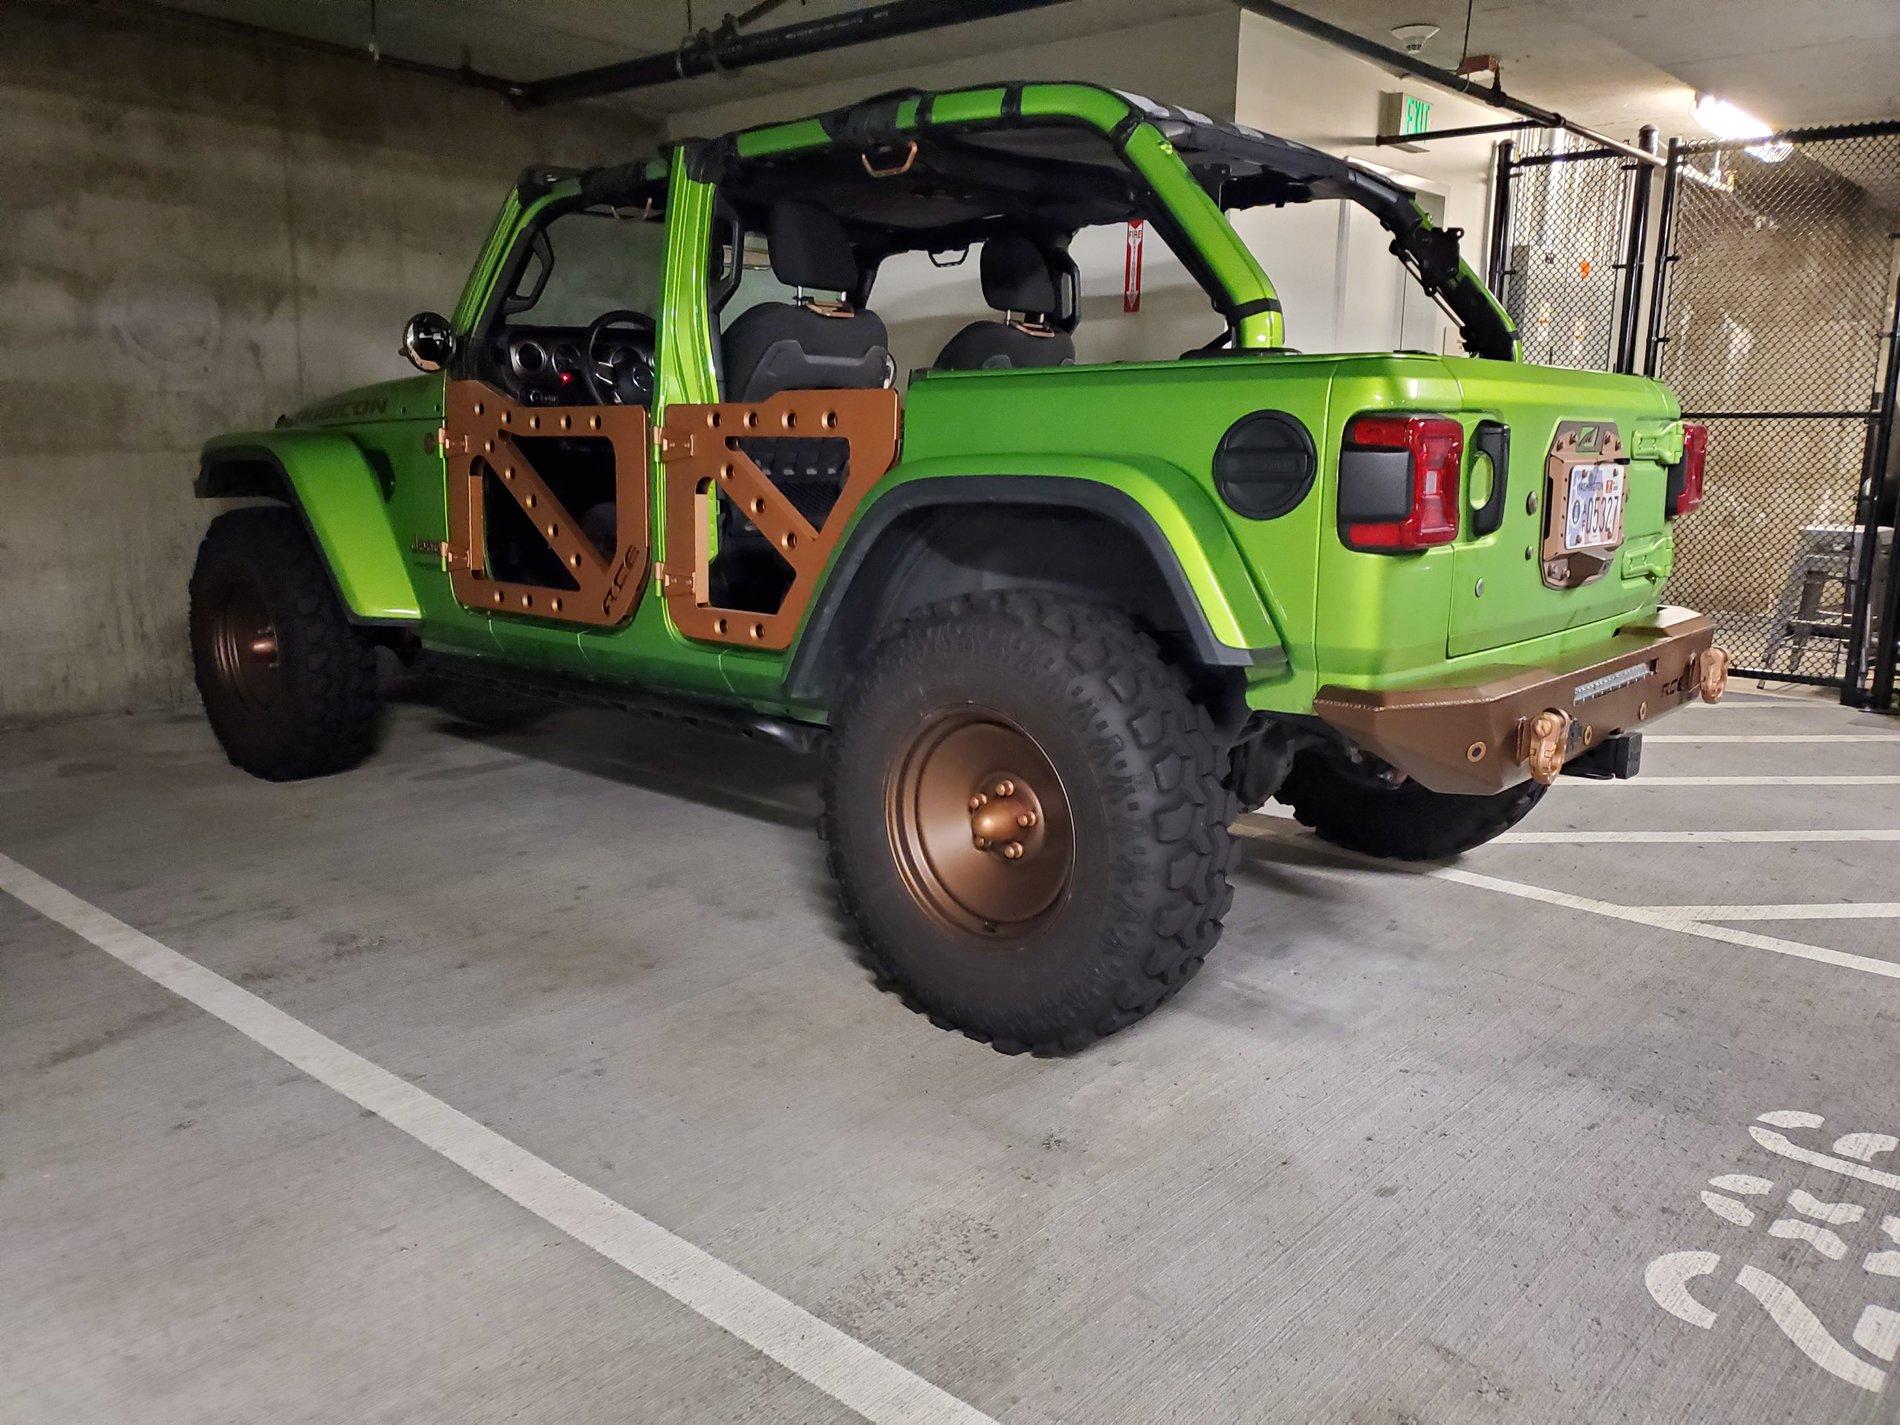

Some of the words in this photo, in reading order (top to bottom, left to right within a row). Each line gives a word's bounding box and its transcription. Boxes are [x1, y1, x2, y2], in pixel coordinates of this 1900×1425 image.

[1406, 96, 1431, 134] EXIT
[296, 399, 388, 422] RUBICON
[1585, 496, 1619, 534] 05327
